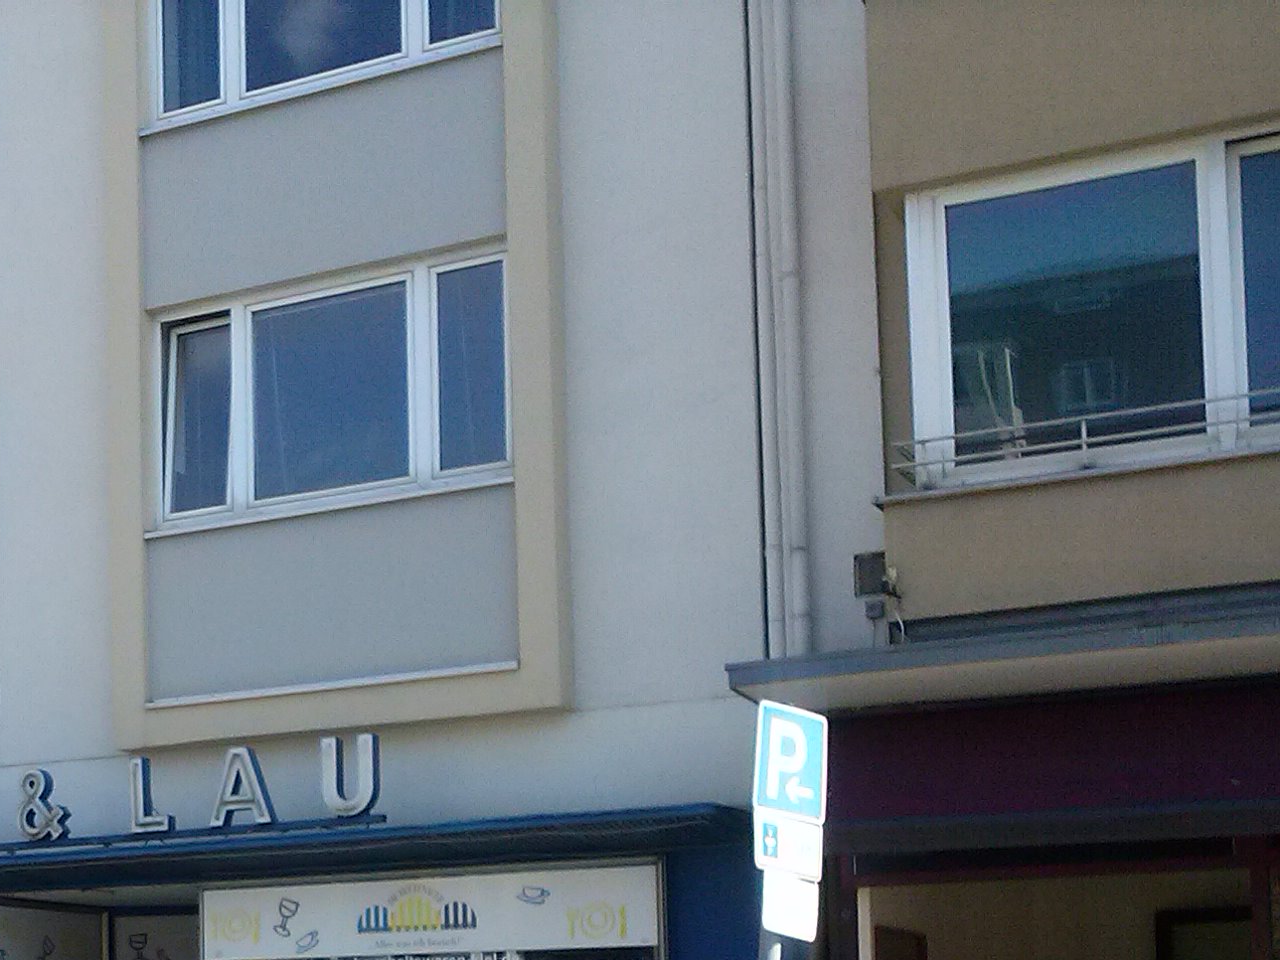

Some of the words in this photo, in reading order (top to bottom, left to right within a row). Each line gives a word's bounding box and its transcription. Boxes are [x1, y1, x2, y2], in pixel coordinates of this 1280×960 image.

[20, 768, 70, 841] &
[130, 733, 381, 834] LAU
[766, 716, 808, 801] P
